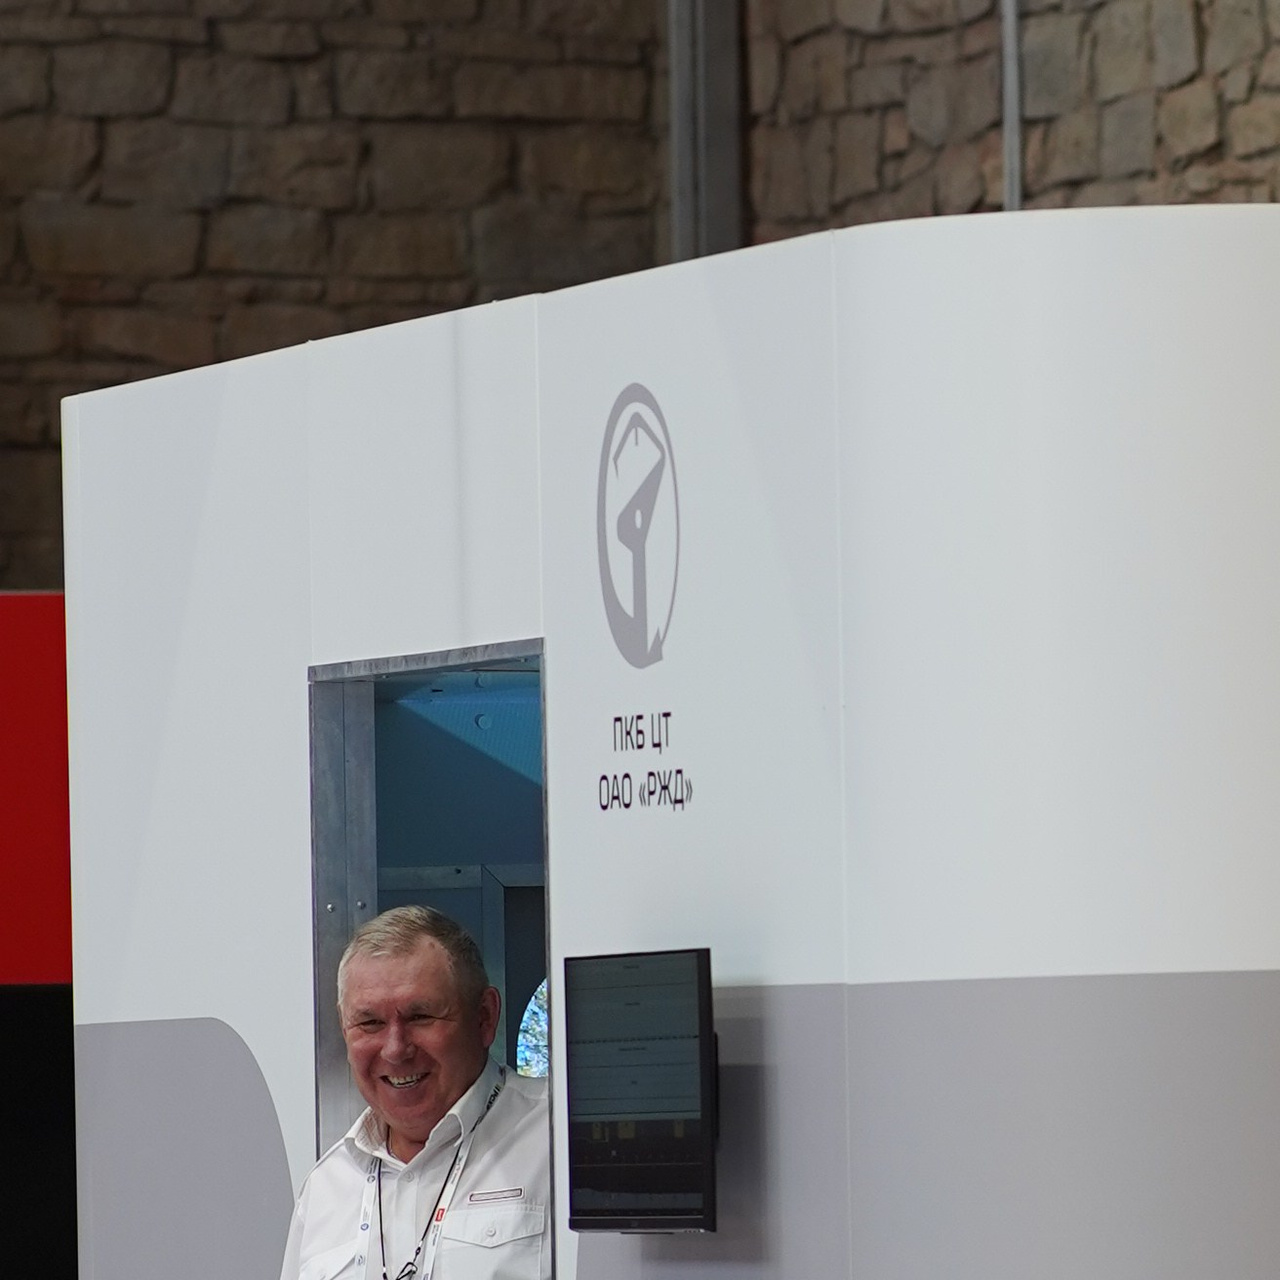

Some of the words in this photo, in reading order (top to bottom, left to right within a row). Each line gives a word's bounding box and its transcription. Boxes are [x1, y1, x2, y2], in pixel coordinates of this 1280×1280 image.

[613, 714, 645, 752] ПКБ
[651, 711, 672, 755] ЦТ
[599, 772, 632, 811] ОАО
[638, 768, 693, 812] «РЖД»
